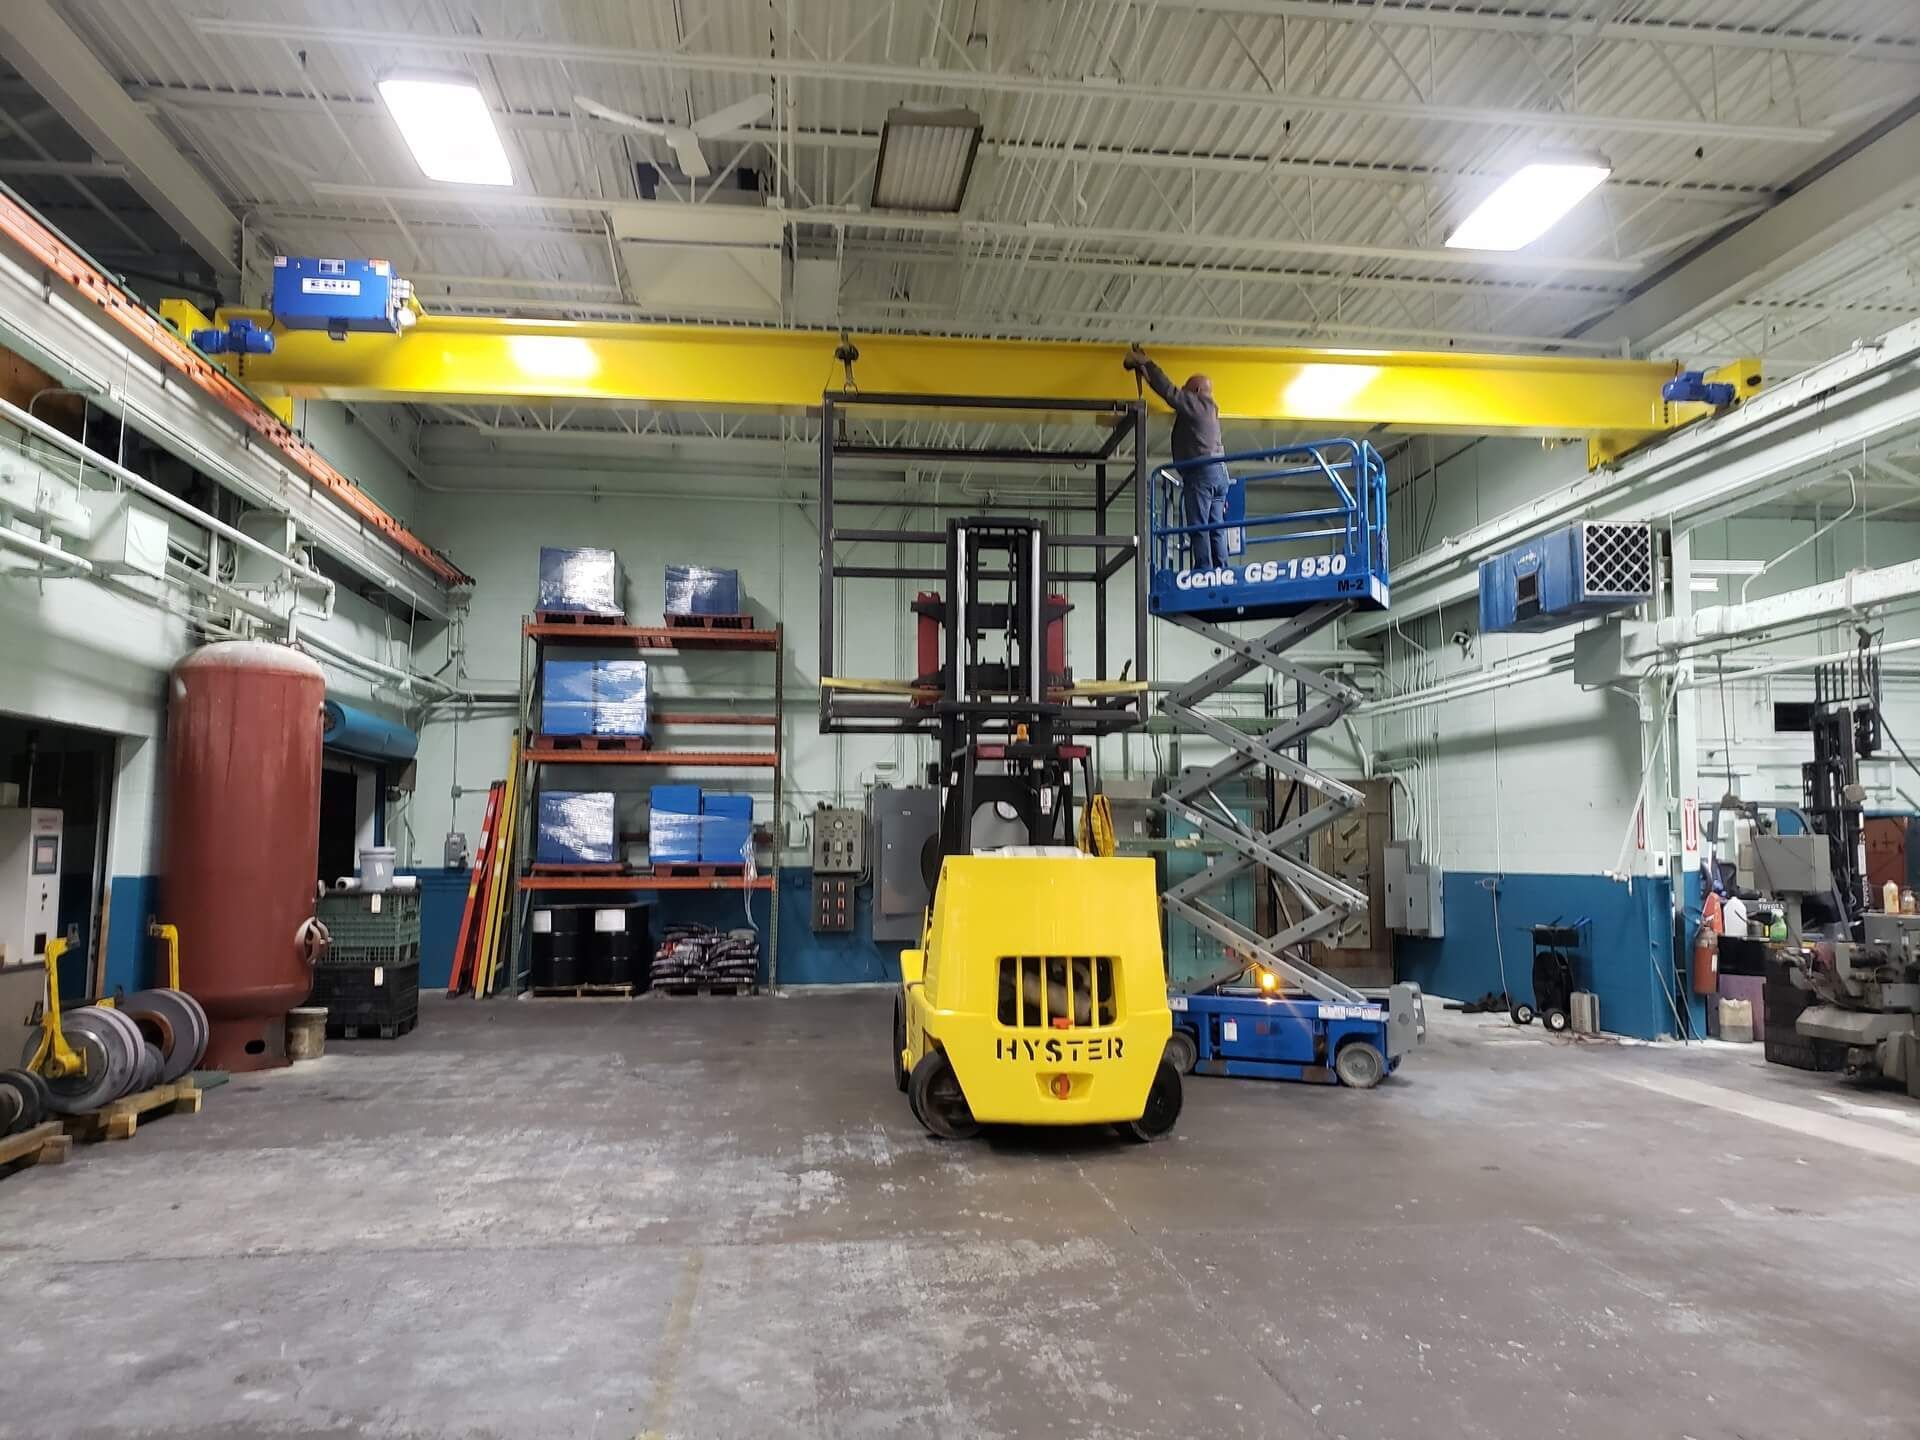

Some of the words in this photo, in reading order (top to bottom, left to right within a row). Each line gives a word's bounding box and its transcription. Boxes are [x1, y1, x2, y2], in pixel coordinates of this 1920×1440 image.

[1176, 567, 1235, 591] Genie
[1244, 554, 1347, 584] GS-1930
[1337, 578, 1364, 592] M-2
[996, 1037, 1124, 1062] HYSTER
